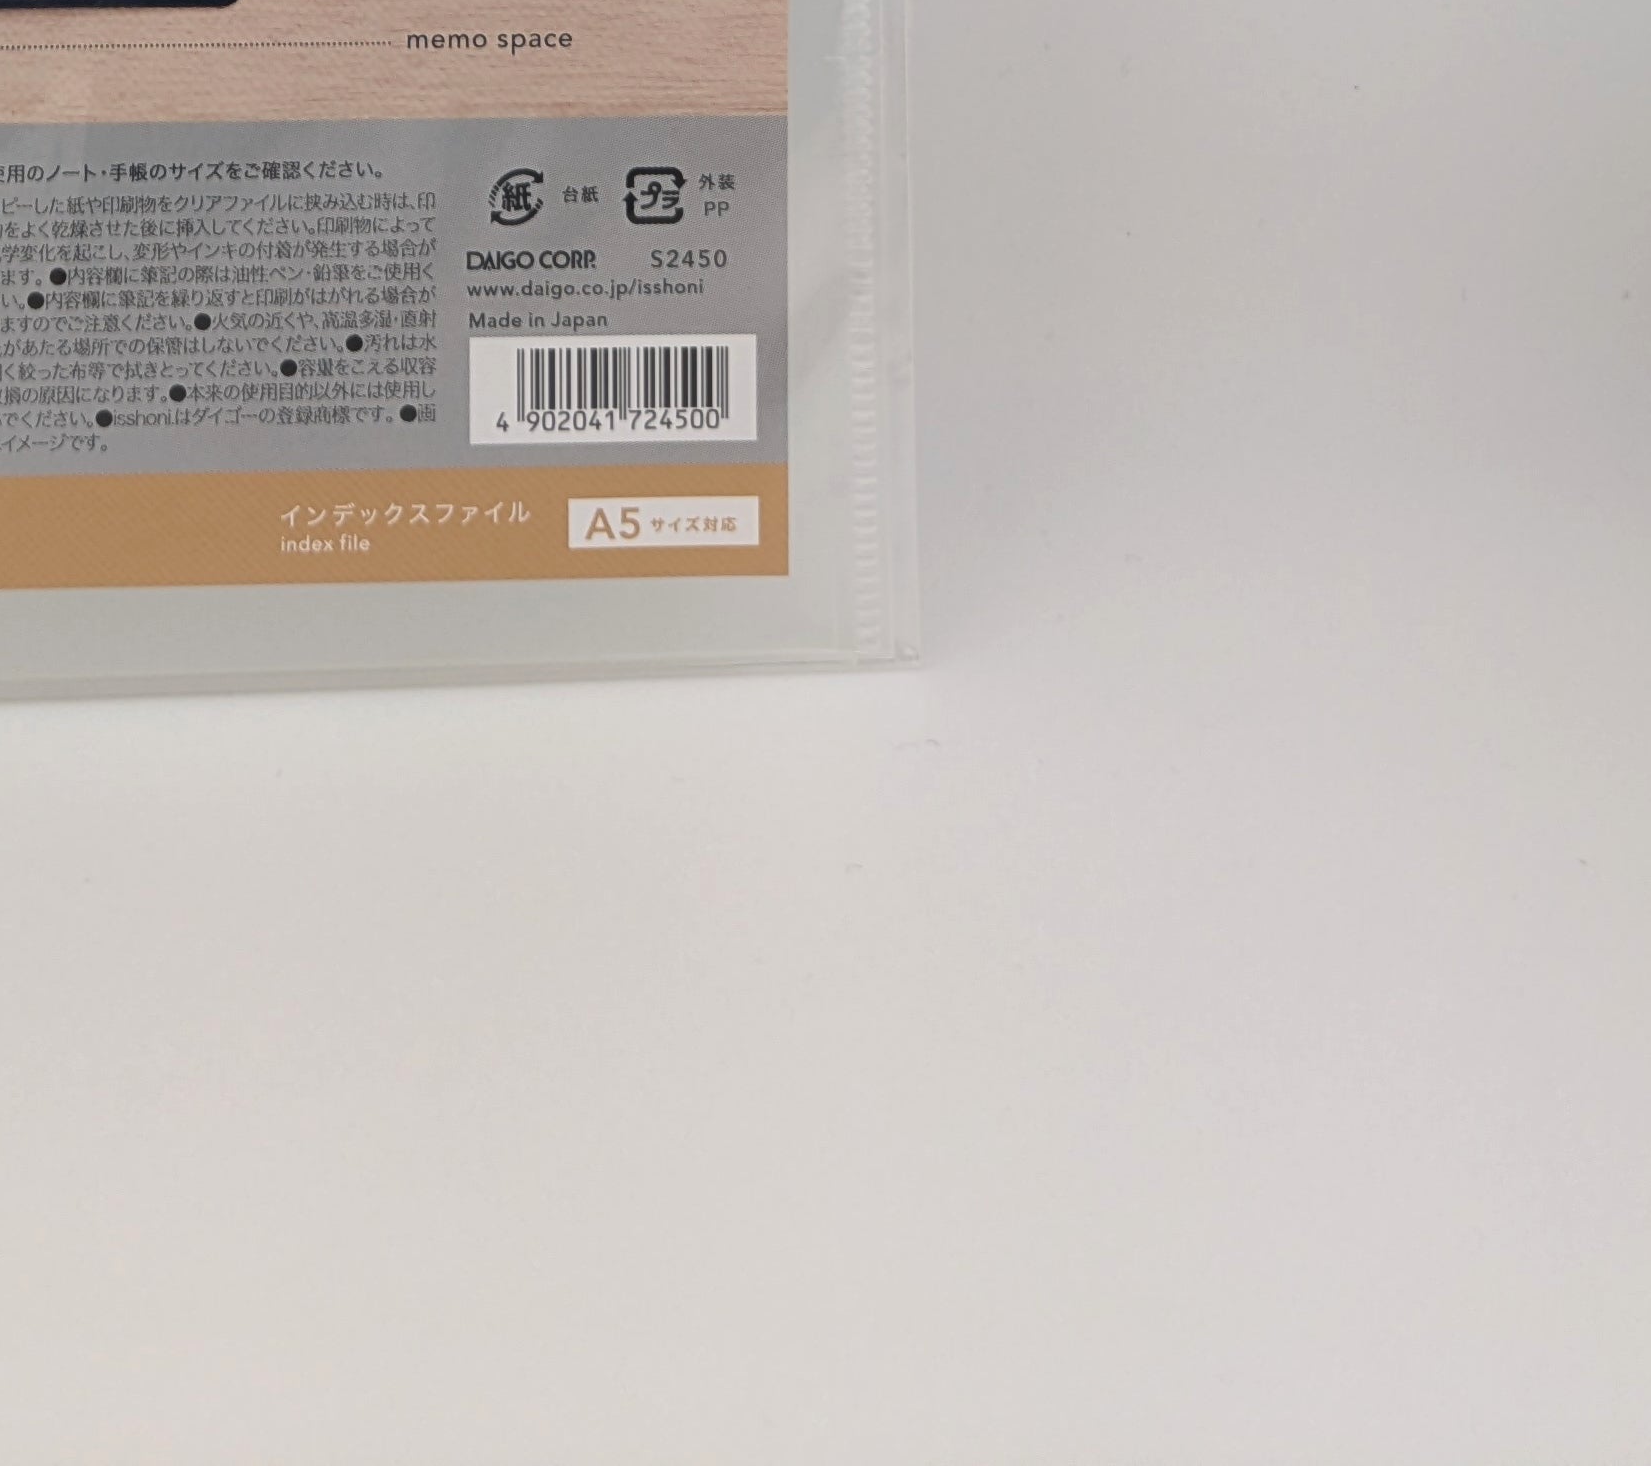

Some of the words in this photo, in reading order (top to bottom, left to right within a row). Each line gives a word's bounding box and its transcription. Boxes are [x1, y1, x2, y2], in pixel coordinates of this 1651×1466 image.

[406, 30, 488, 48] memo
[496, 29, 573, 56] space
[698, 172, 736, 191] 外装
[501, 180, 532, 212] 紙
[561, 185, 599, 204] 台紙
[639, 179, 681, 210] プラ
[703, 200, 731, 217] PP
[466, 249, 535, 270] DAIGO
[538, 248, 597, 270] CORP.
[650, 248, 728, 269] S2450
[466, 278, 705, 301] www.daigo.co.jp/isshoni
[468, 311, 522, 329] Made
[528, 311, 545, 328] in
[550, 311, 608, 331] Japan
[496, 411, 510, 432] 4
[526, 409, 616, 432] 902041
[628, 407, 721, 431] 724500
[279, 500, 532, 528] インデックスファイル
[584, 507, 642, 541] A5
[650, 515, 738, 534] サイズ対応
[280, 535, 334, 553] index
[338, 533, 371, 552] file
